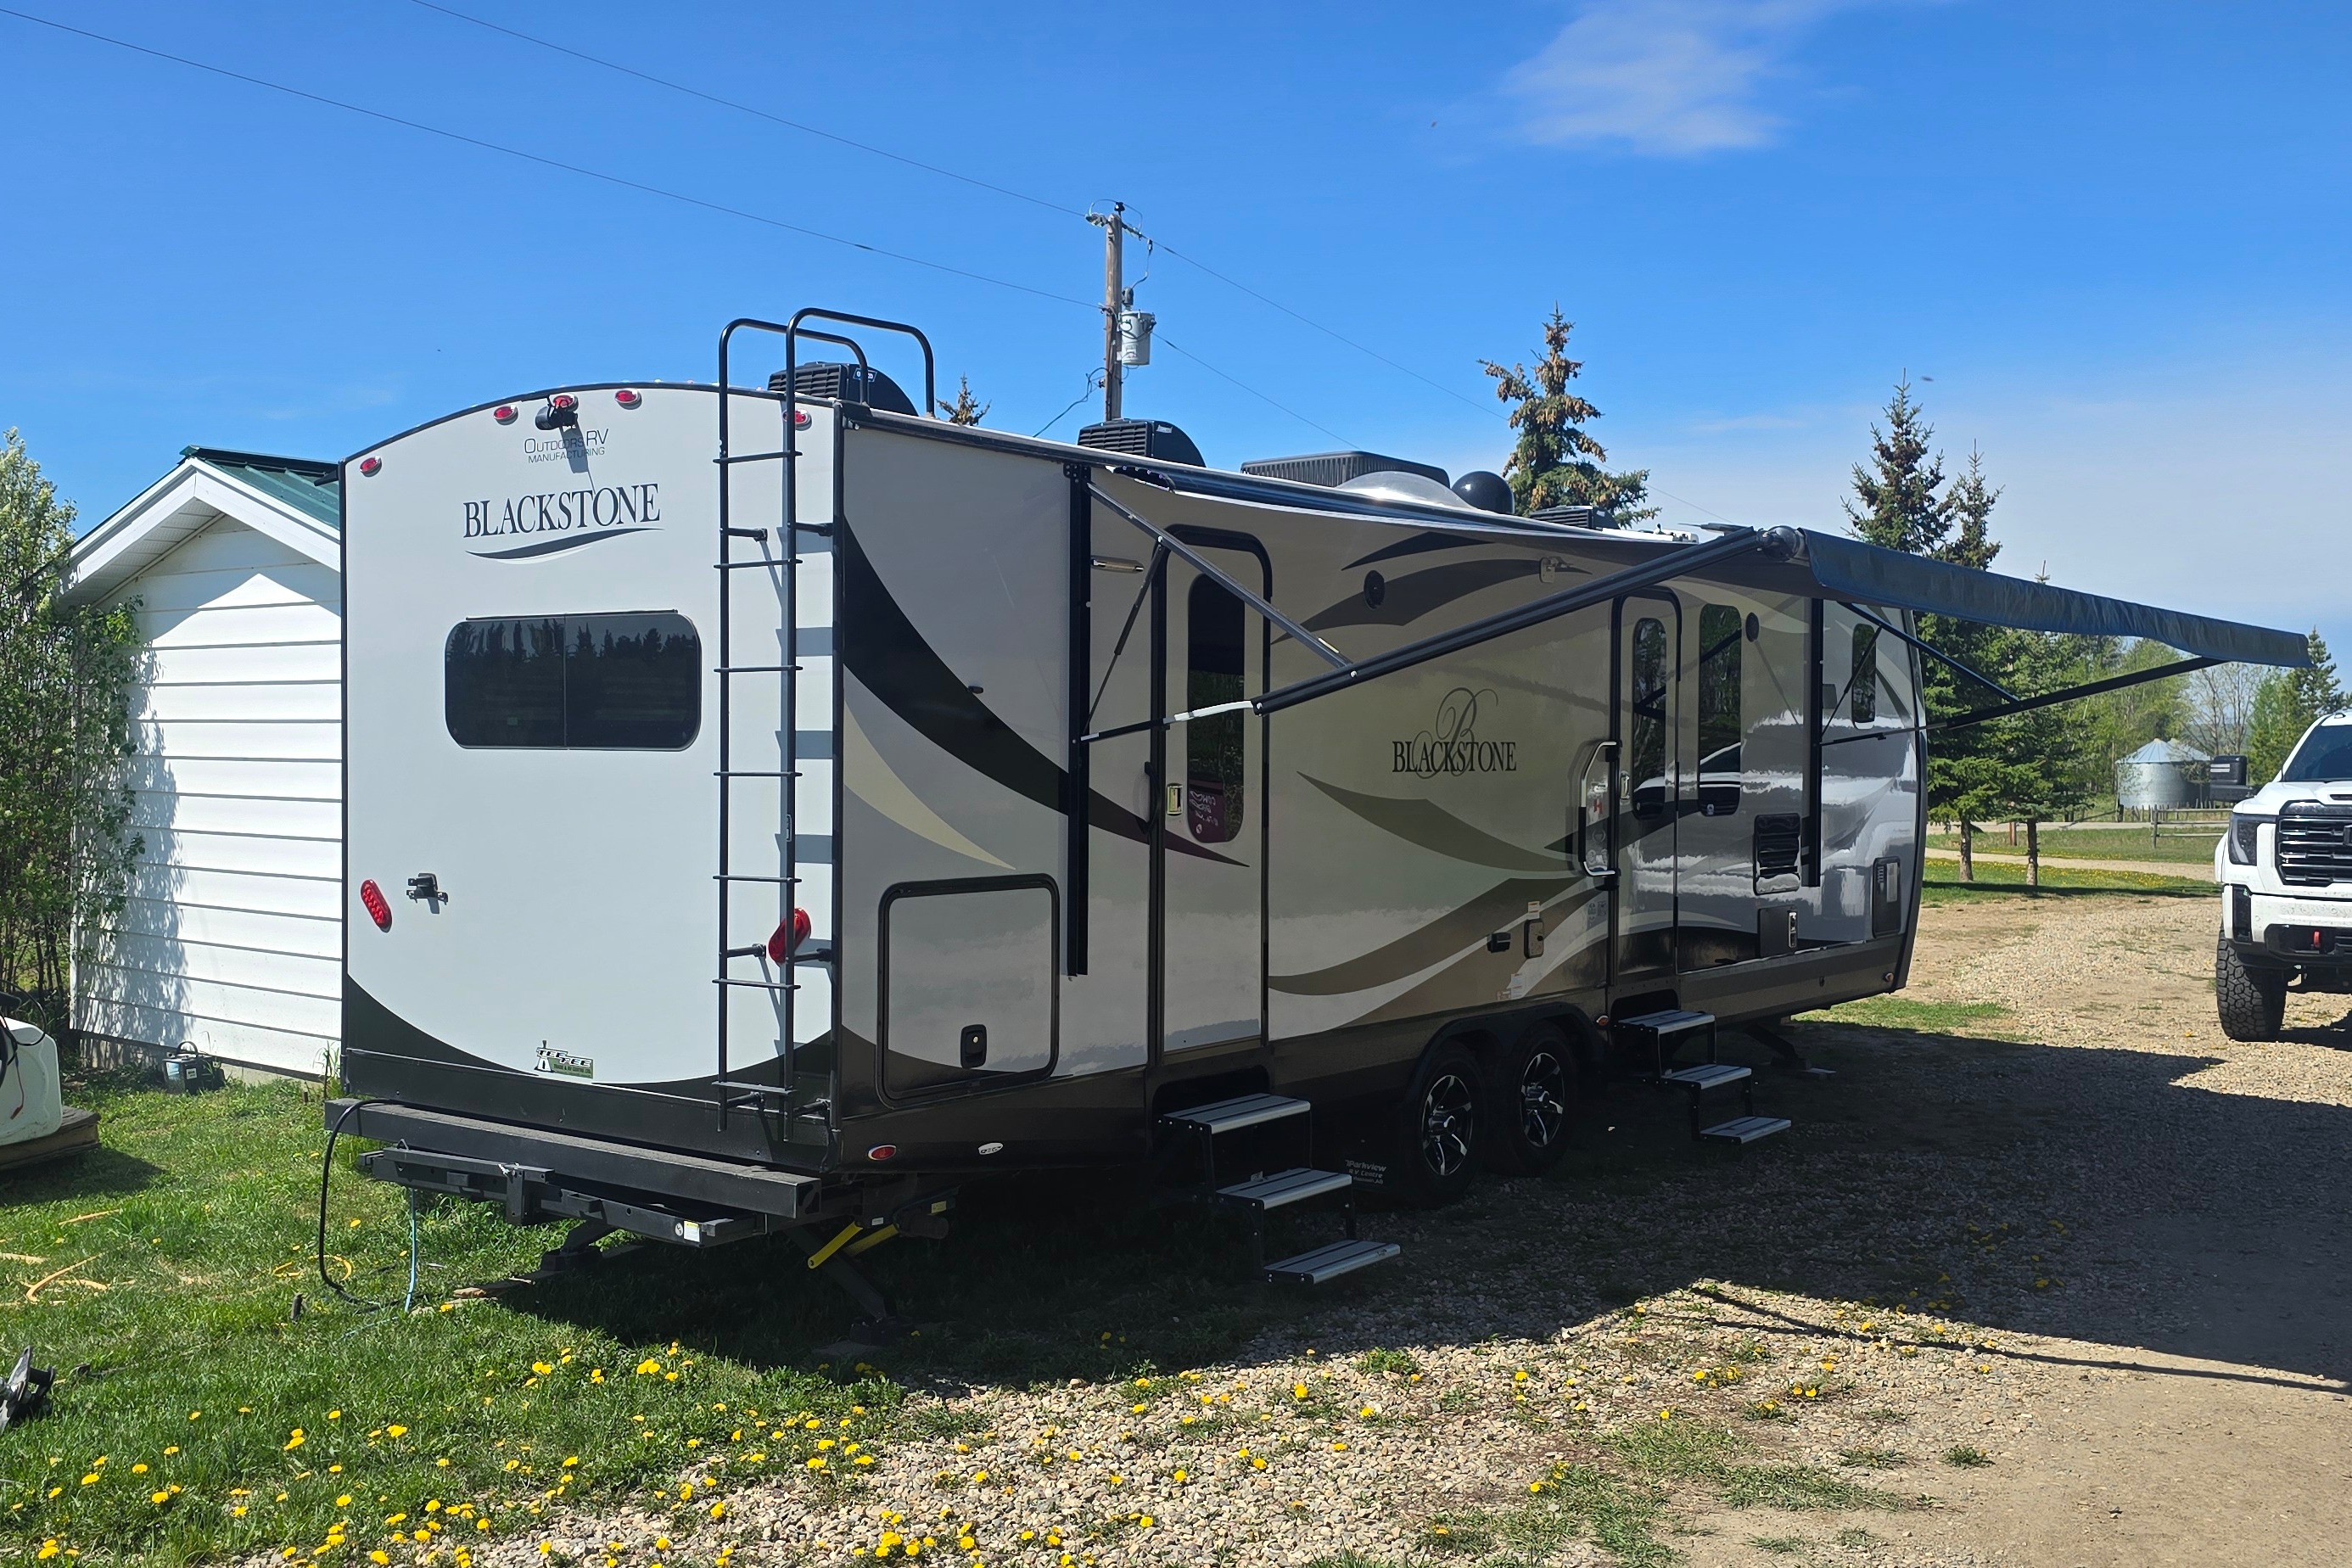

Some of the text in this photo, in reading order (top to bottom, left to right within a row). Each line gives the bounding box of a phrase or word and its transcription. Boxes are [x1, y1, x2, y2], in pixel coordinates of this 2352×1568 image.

[528, 446, 605, 464] MANUFACTURING
[463, 483, 660, 538] BLACKSTONE
[1392, 740, 1517, 773] BLACKSTONE
[1347, 1160, 1387, 1172] Parkview
